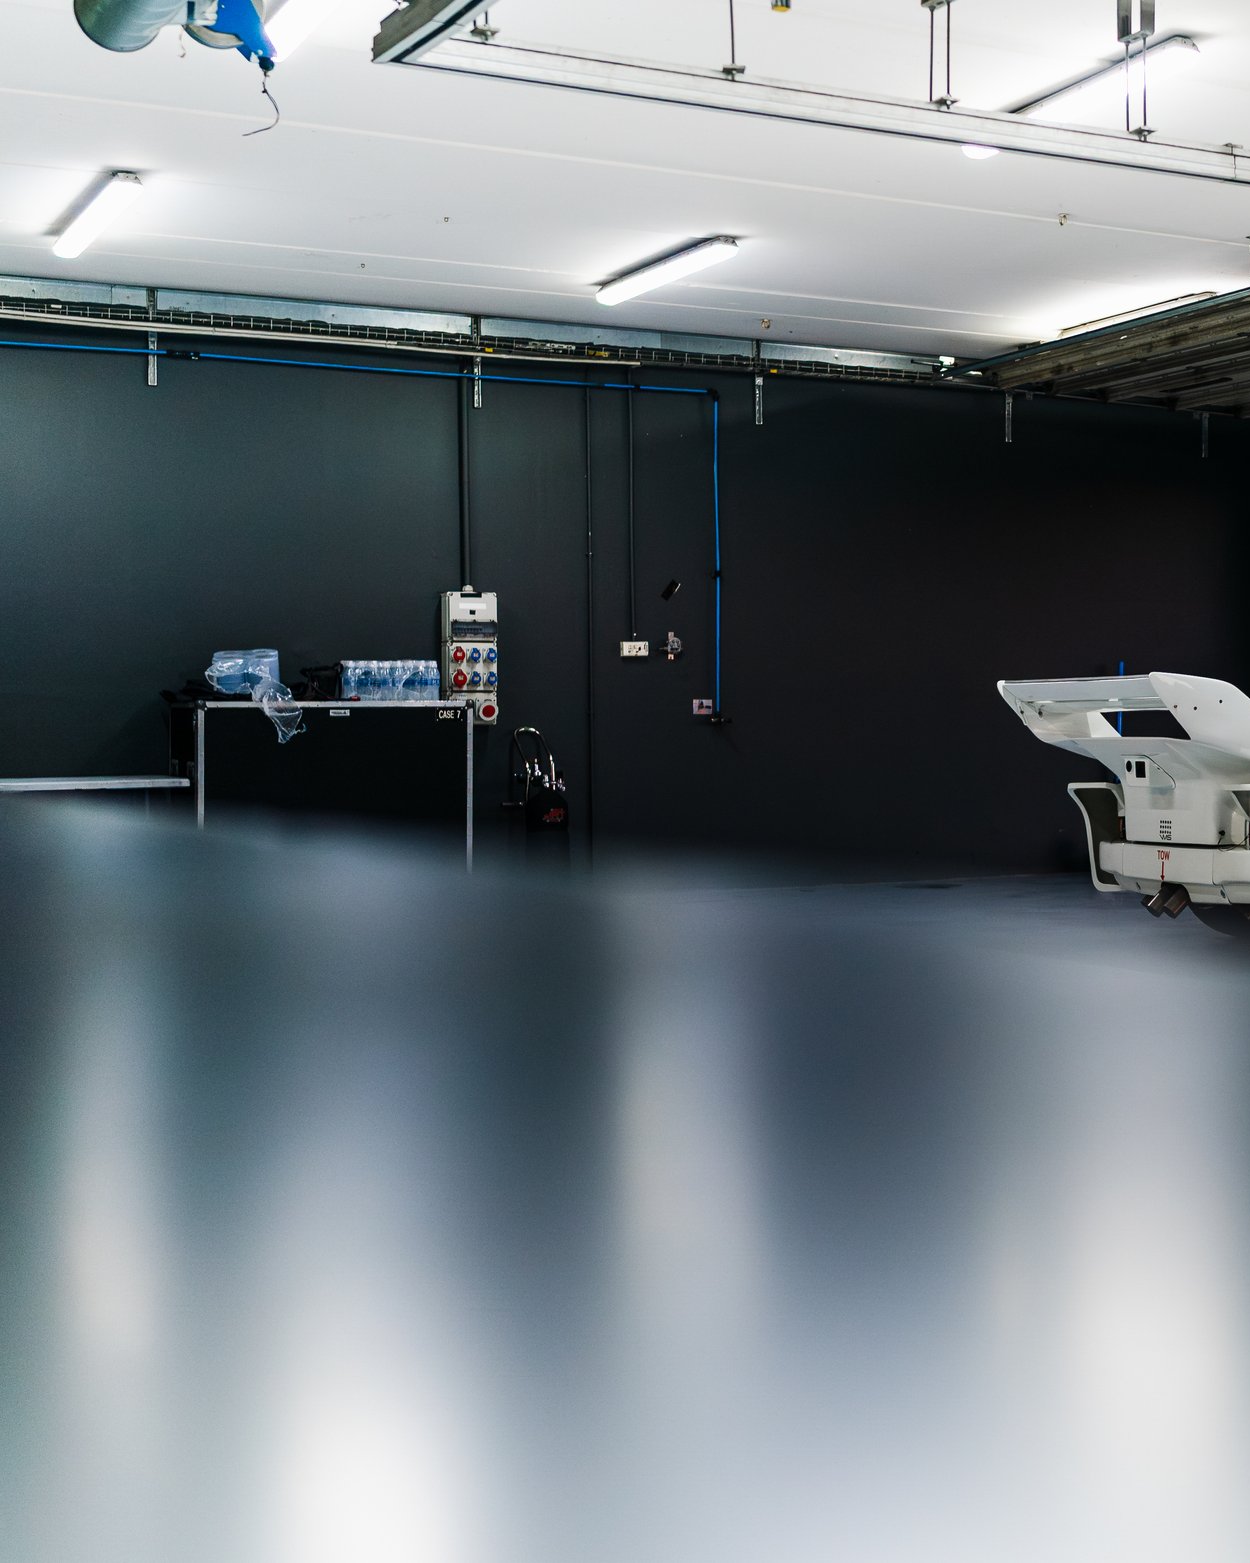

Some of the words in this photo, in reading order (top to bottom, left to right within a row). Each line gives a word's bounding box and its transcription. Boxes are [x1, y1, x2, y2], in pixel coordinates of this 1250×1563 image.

[438, 710, 455, 719] CASE
[456, 710, 462, 719] 7
[1157, 849, 1170, 861] TOW
